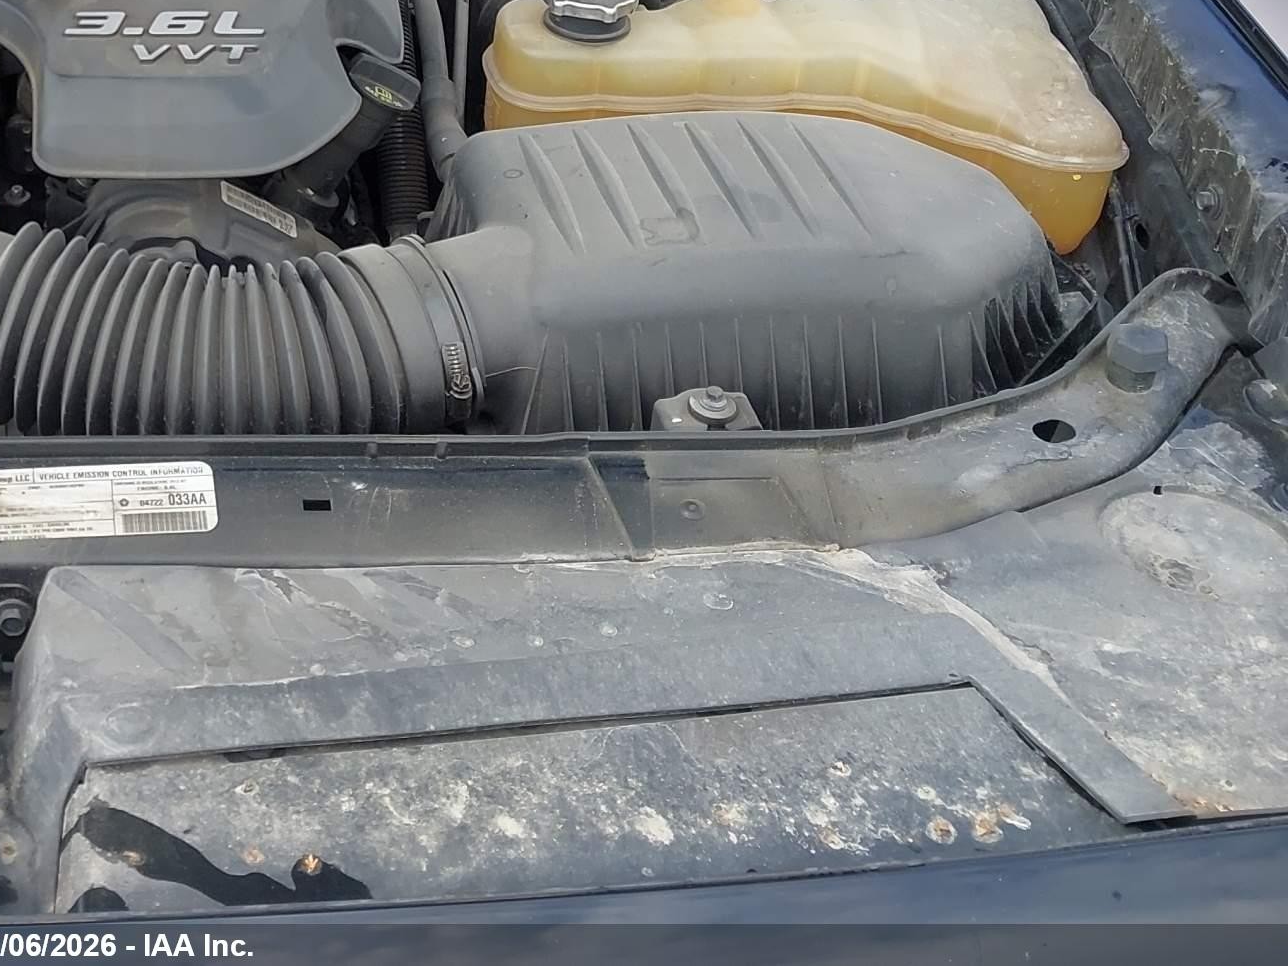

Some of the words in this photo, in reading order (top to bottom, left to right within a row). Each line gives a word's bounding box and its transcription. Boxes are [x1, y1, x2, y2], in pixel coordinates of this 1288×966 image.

[64, 11, 265, 36] 3.6L
[132, 44, 259, 64] VVT
[15, 474, 30, 482] LLC
[39, 472, 69, 481] VEHICLE
[73, 469, 110, 479] EMISSION
[112, 469, 147, 477] CONTROL
[150, 467, 203, 476] INFORMATION
[168, 493, 207, 506] 033AA
